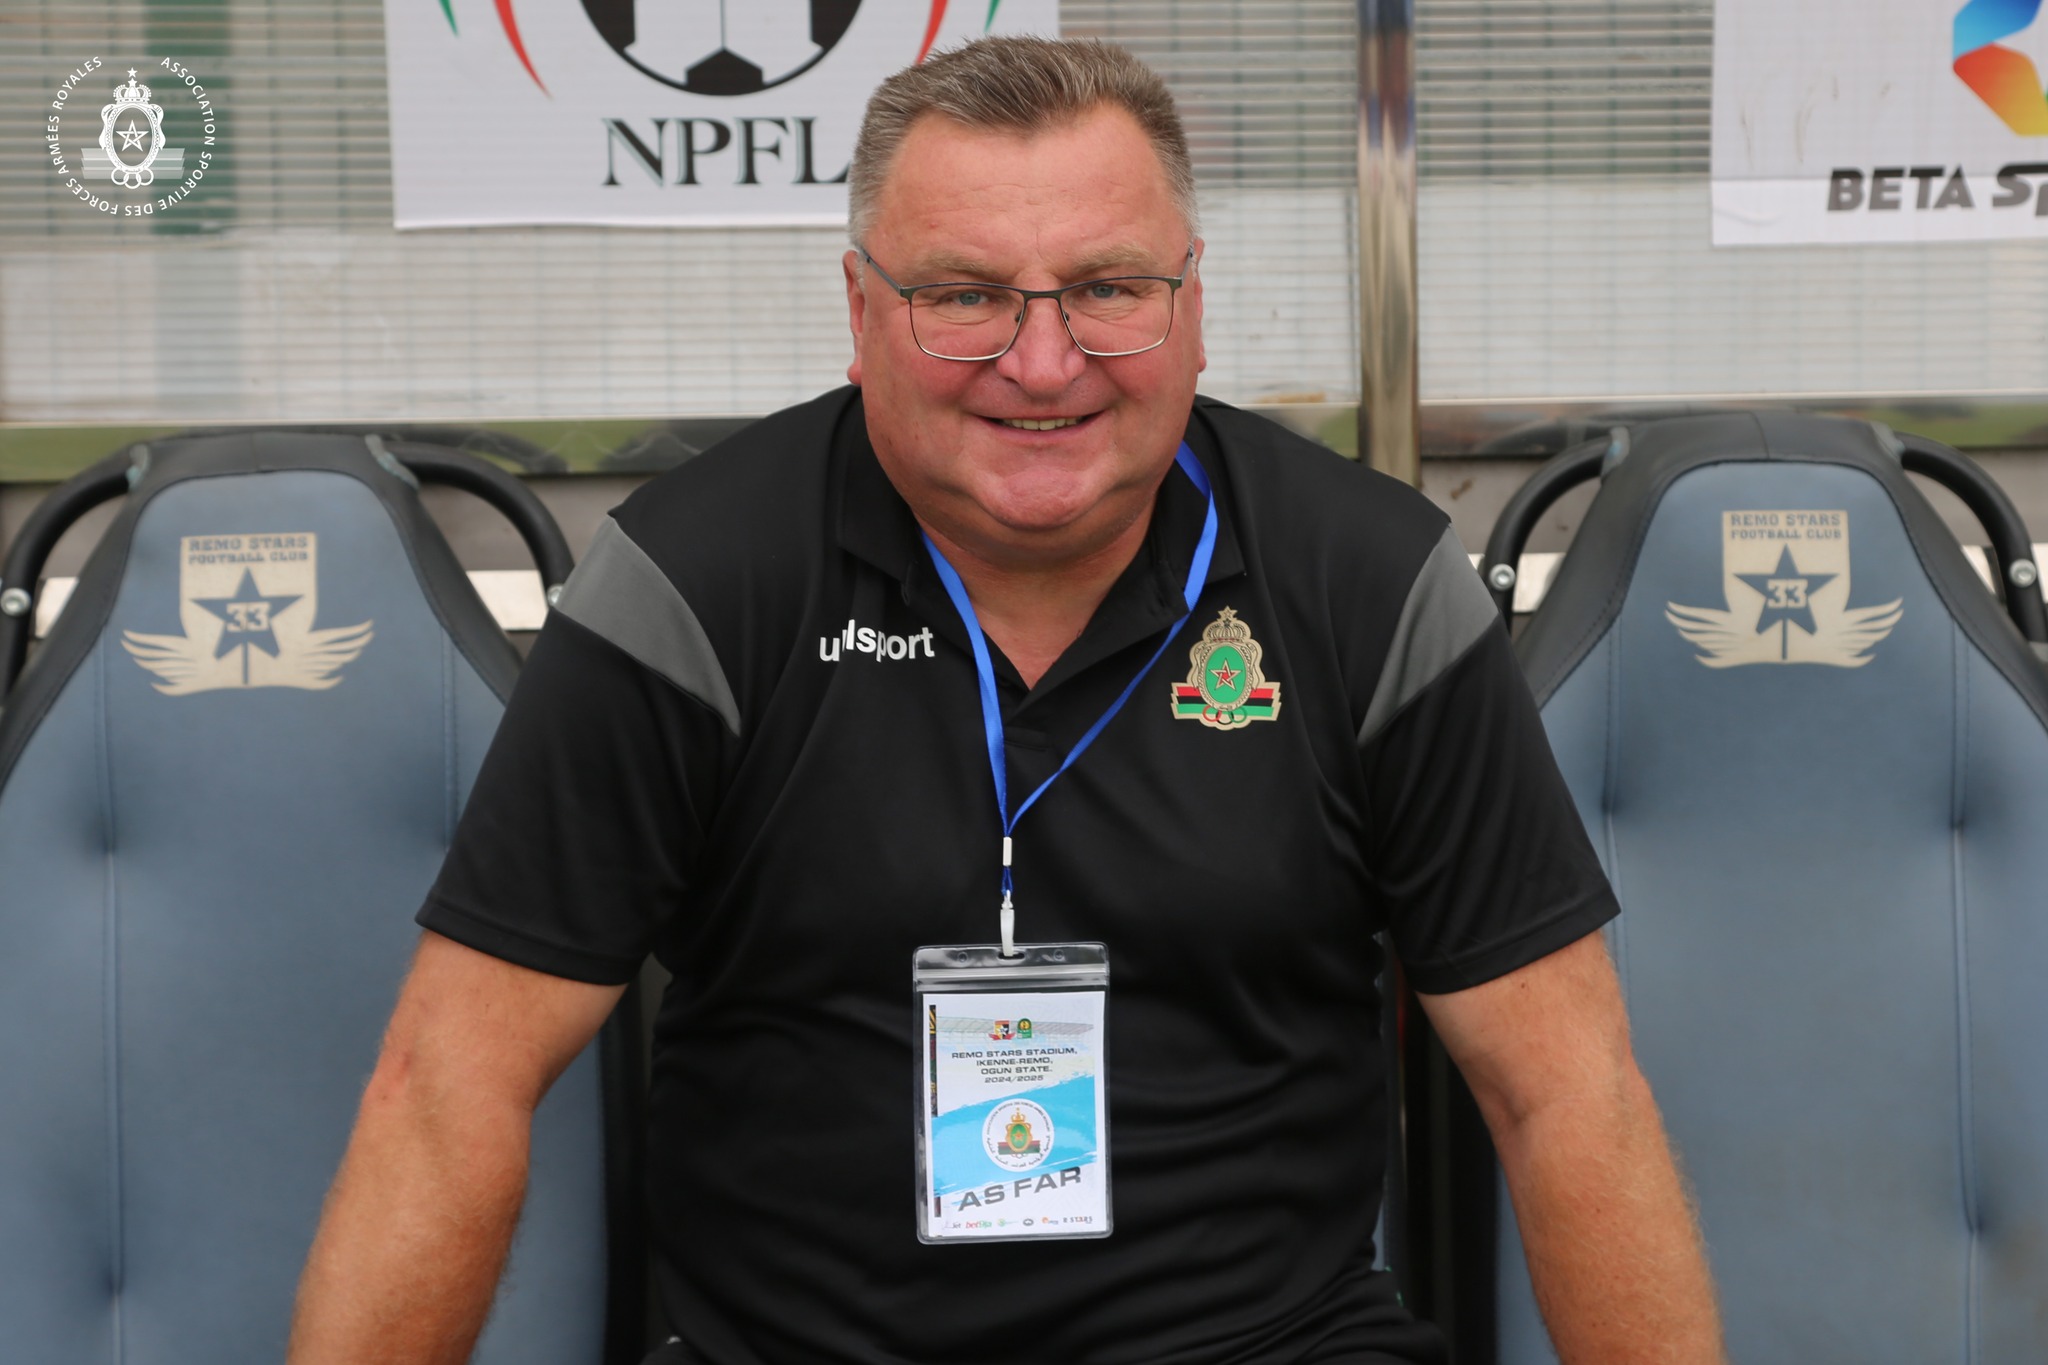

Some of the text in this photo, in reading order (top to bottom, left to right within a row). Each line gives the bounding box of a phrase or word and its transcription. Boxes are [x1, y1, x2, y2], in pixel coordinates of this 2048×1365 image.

[601, 116, 850, 188] NPFL
[1827, 163, 1976, 212] BETA
[1730, 513, 1841, 527] REMO STARS
[1730, 528, 1842, 540] FOOTBALL CLUB
[188, 536, 309, 552] REMO STARS
[188, 550, 309, 565] FOOTBALL CLUB
[1767, 578, 1809, 609] 33
[226, 602, 271, 632] 33
[951, 1047, 1078, 1059] REMO STARS STADIUM,
[981, 1067, 1012, 1075] OGUN
[984, 1074, 1044, 1084] 2024/2025
[957, 1166, 1082, 1212] AS FAR
